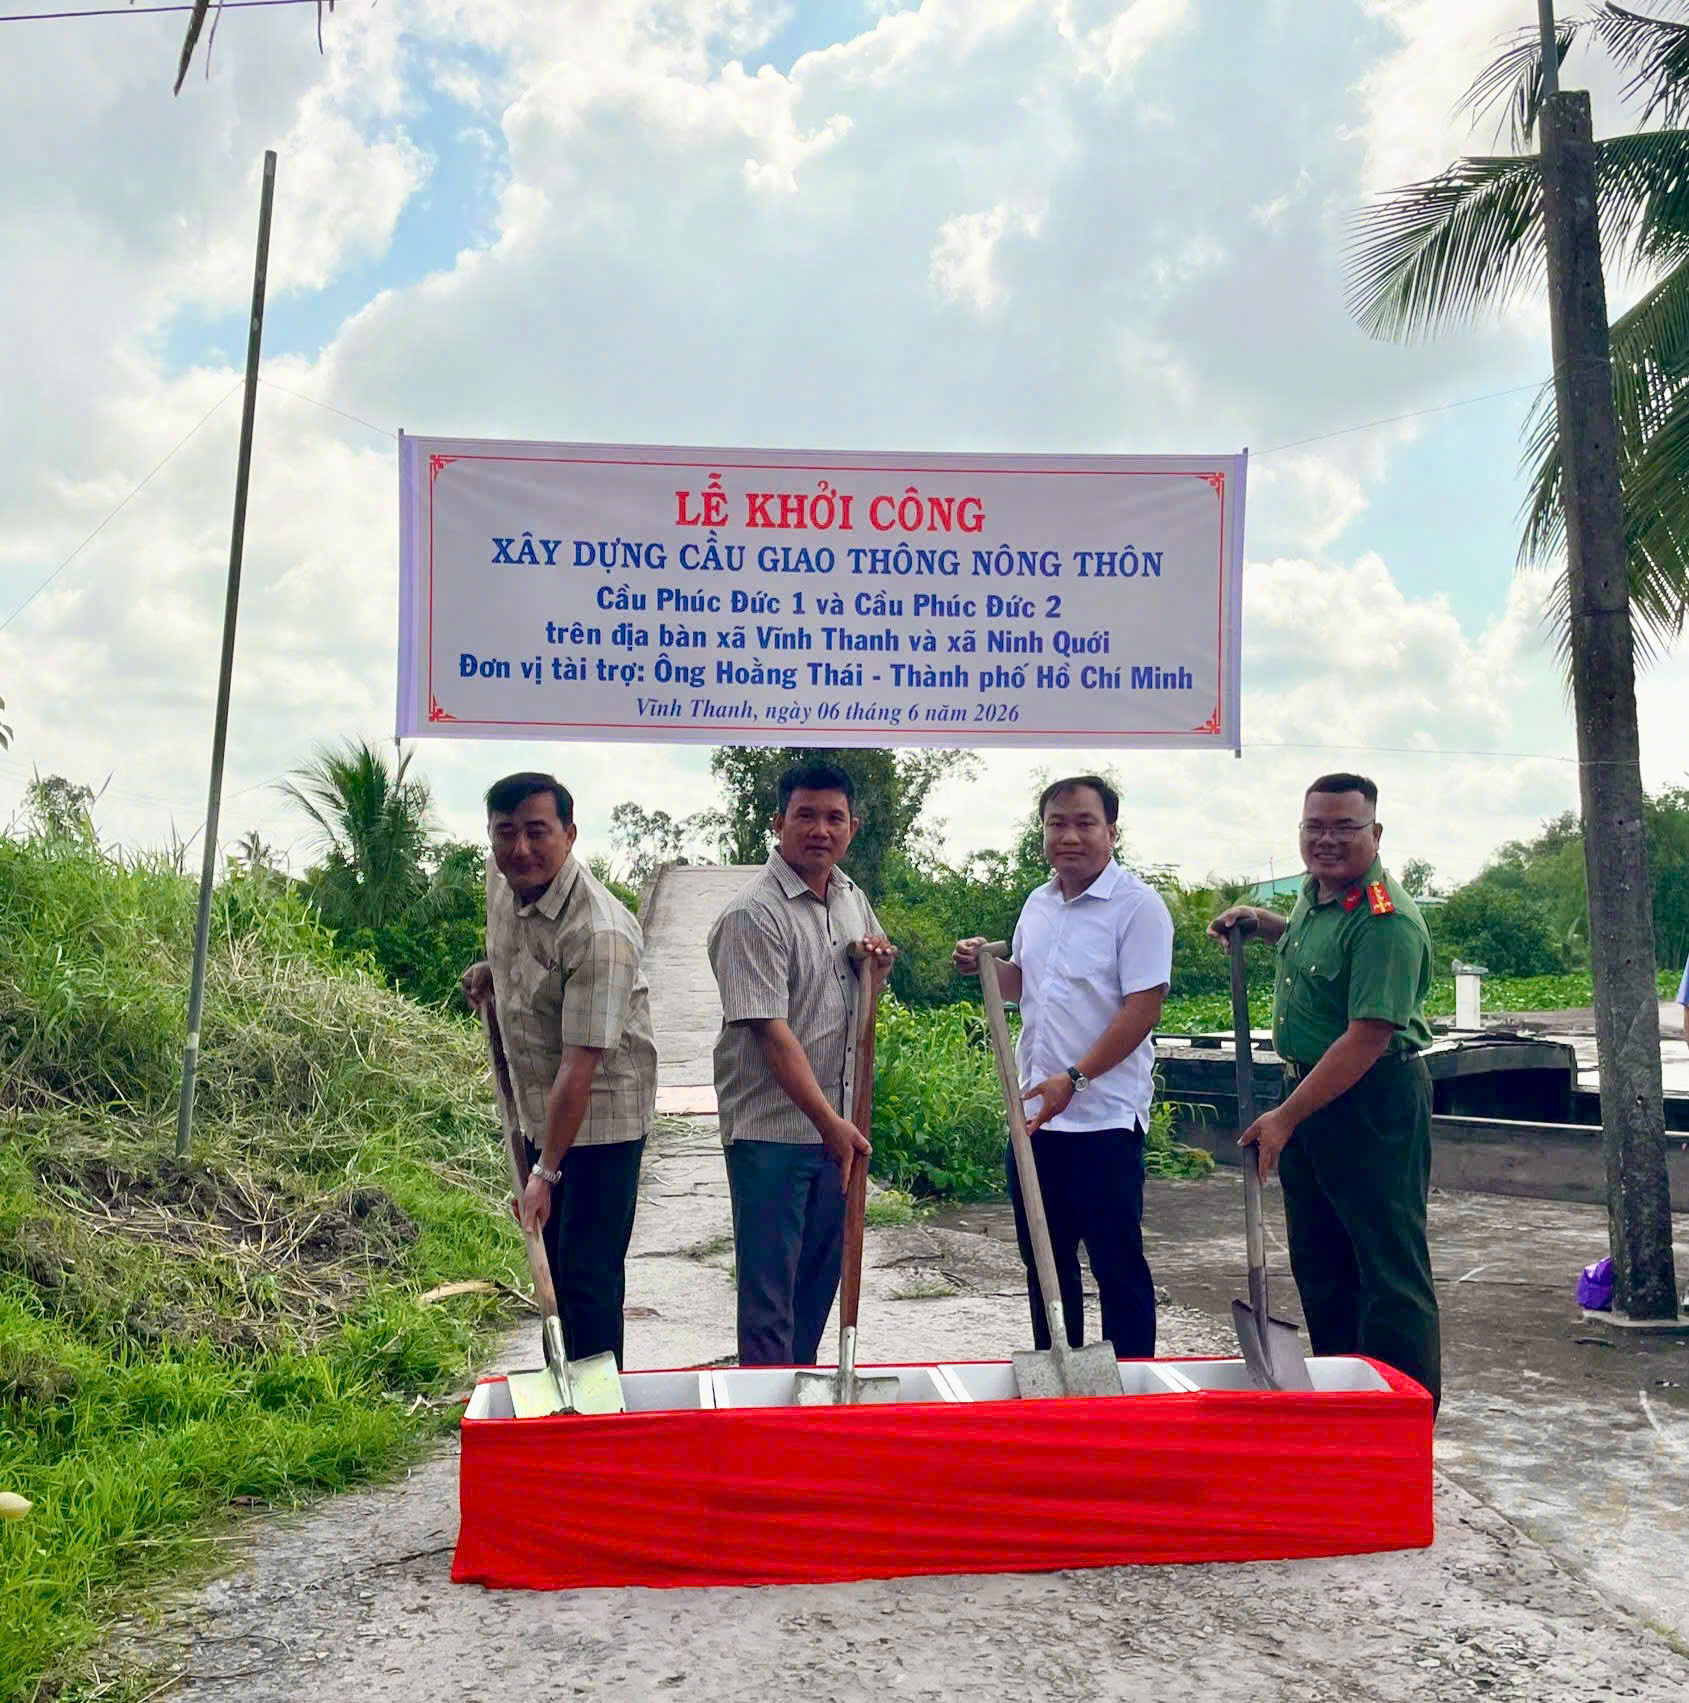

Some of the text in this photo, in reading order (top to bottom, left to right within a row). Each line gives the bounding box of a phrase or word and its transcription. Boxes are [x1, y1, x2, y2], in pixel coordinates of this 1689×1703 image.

[675, 473, 986, 533] LỄ KHỞI CÔNG
[492, 529, 1164, 578] XÂY DỰNG CẦU GIAO THÔNG NÔNG THÔN
[597, 584, 1062, 619] Cầu Phúc Đức 1 và Cầu Phúc Đức 2
[546, 621, 1110, 658] trên địa bàn xã Vĩnh Thanh và xã Ninh Quới
[459, 654, 510, 678] Đơn
[521, 655, 542, 685] vị
[552, 657, 587, 680] tài
[597, 659, 644, 687] trợ:
[654, 653, 705, 687] Ông
[716, 658, 797, 689] Hoằng
[807, 662, 863, 686] Thái
[890, 663, 969, 688] Thành
[979, 663, 1030, 692] phố
[1037, 663, 1070, 690] Hồ
[1080, 667, 1121, 690] Chí
[1131, 666, 1193, 690] Minh
[636, 698, 1019, 725] Vĩnh Thanh, ngày 06 tháng 6 năm 2026
